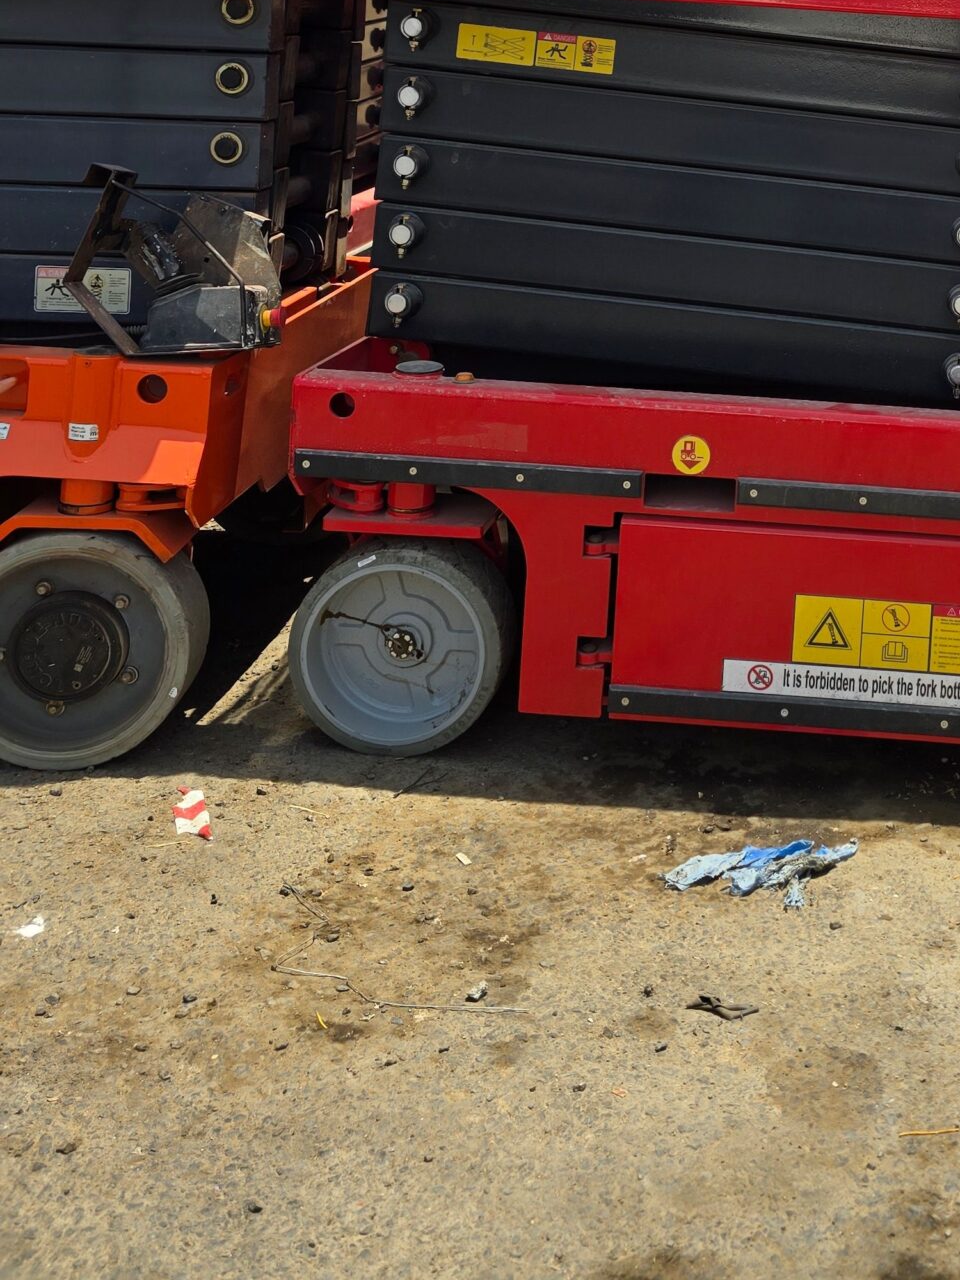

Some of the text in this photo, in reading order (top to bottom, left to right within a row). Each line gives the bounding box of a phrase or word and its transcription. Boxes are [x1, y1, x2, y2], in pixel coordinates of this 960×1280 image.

[783, 668, 791, 687] It
[792, 671, 801, 688] is
[805, 670, 855, 692] forbidden
[858, 677, 869, 693] to
[871, 675, 894, 698] pick
[896, 676, 913, 696] the
[916, 677, 937, 698] fork
